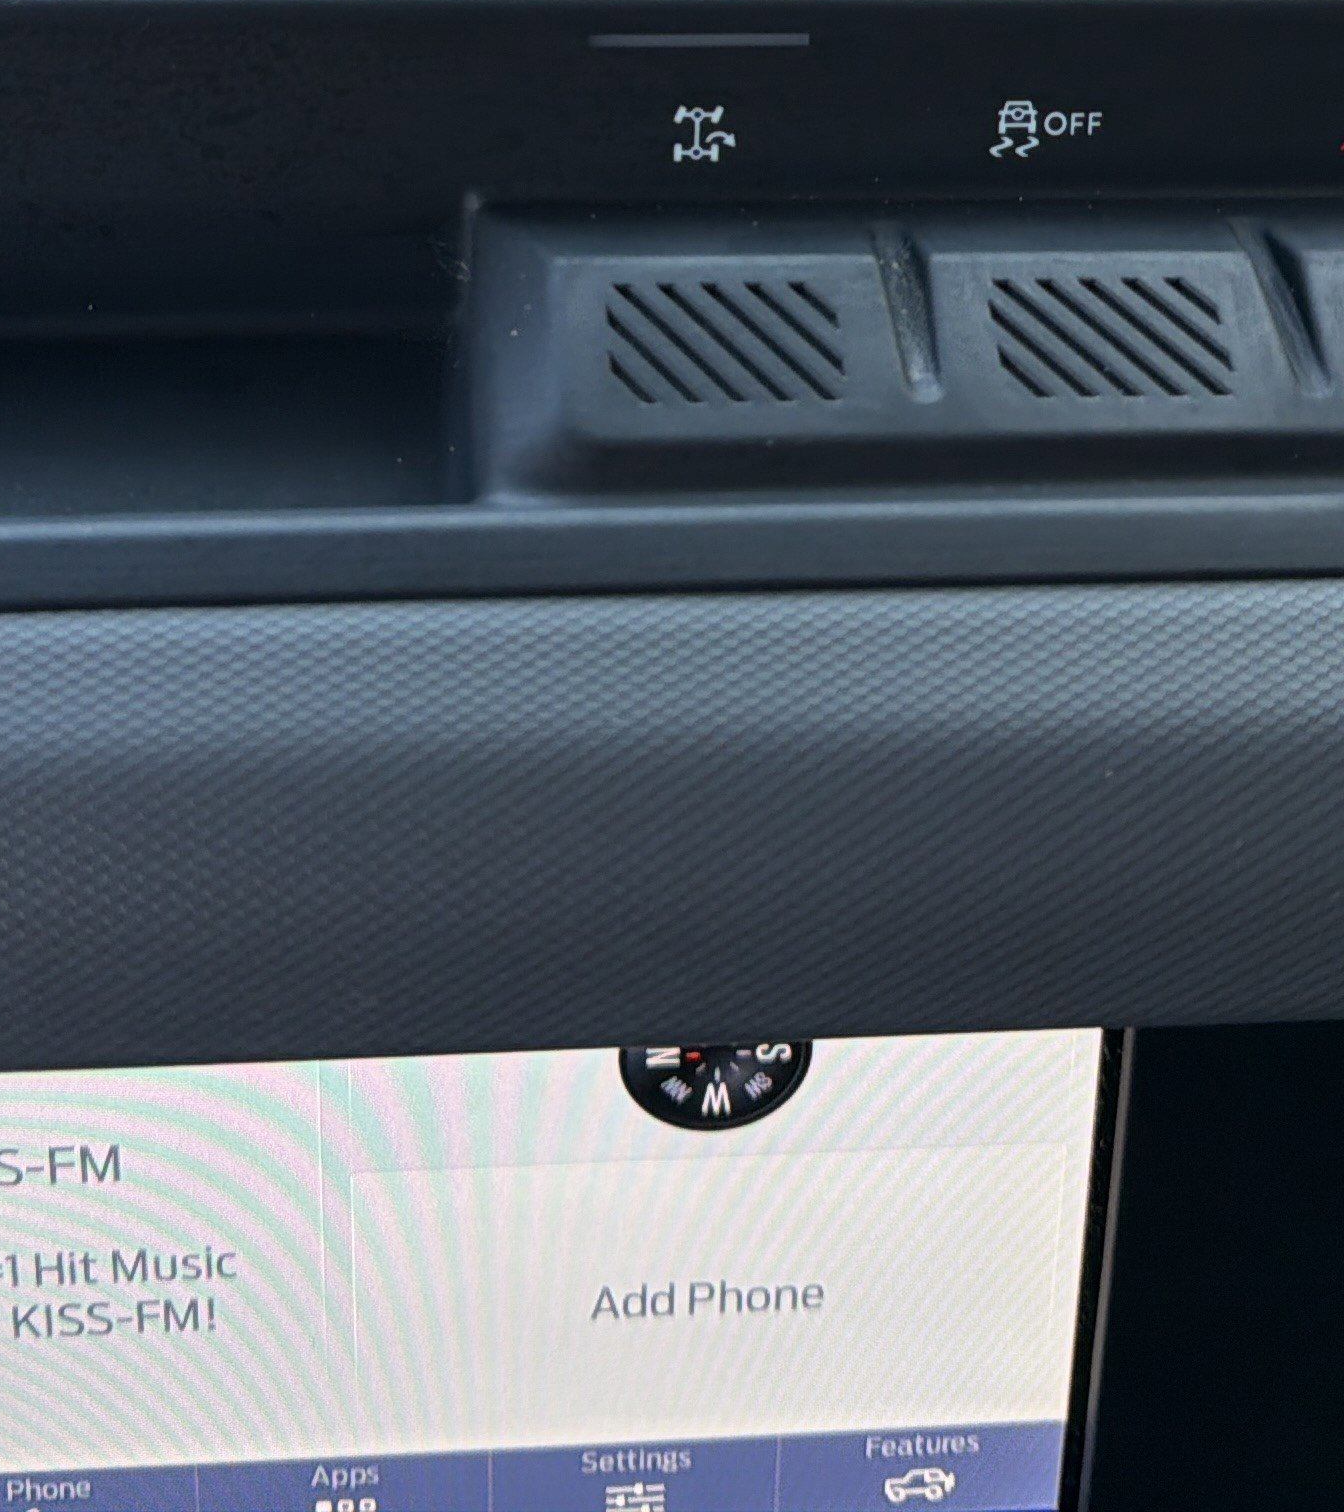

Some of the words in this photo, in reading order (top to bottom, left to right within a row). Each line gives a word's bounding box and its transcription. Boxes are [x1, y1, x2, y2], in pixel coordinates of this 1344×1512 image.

[1044, 111, 1103, 136] OFF
[756, 1043, 793, 1064] S
[701, 1081, 731, 1116] W
[34, 1251, 98, 1287] Hit
[112, 1245, 237, 1284] Music
[591, 1281, 674, 1320] Add
[689, 1279, 824, 1316] Phone
[12, 1296, 216, 1339] KISS-FM!
[865, 1433, 980, 1459] Features
[581, 1448, 692, 1475] Settings
[6, 1477, 91, 1502] Phone
[311, 1463, 379, 1490] Apps
